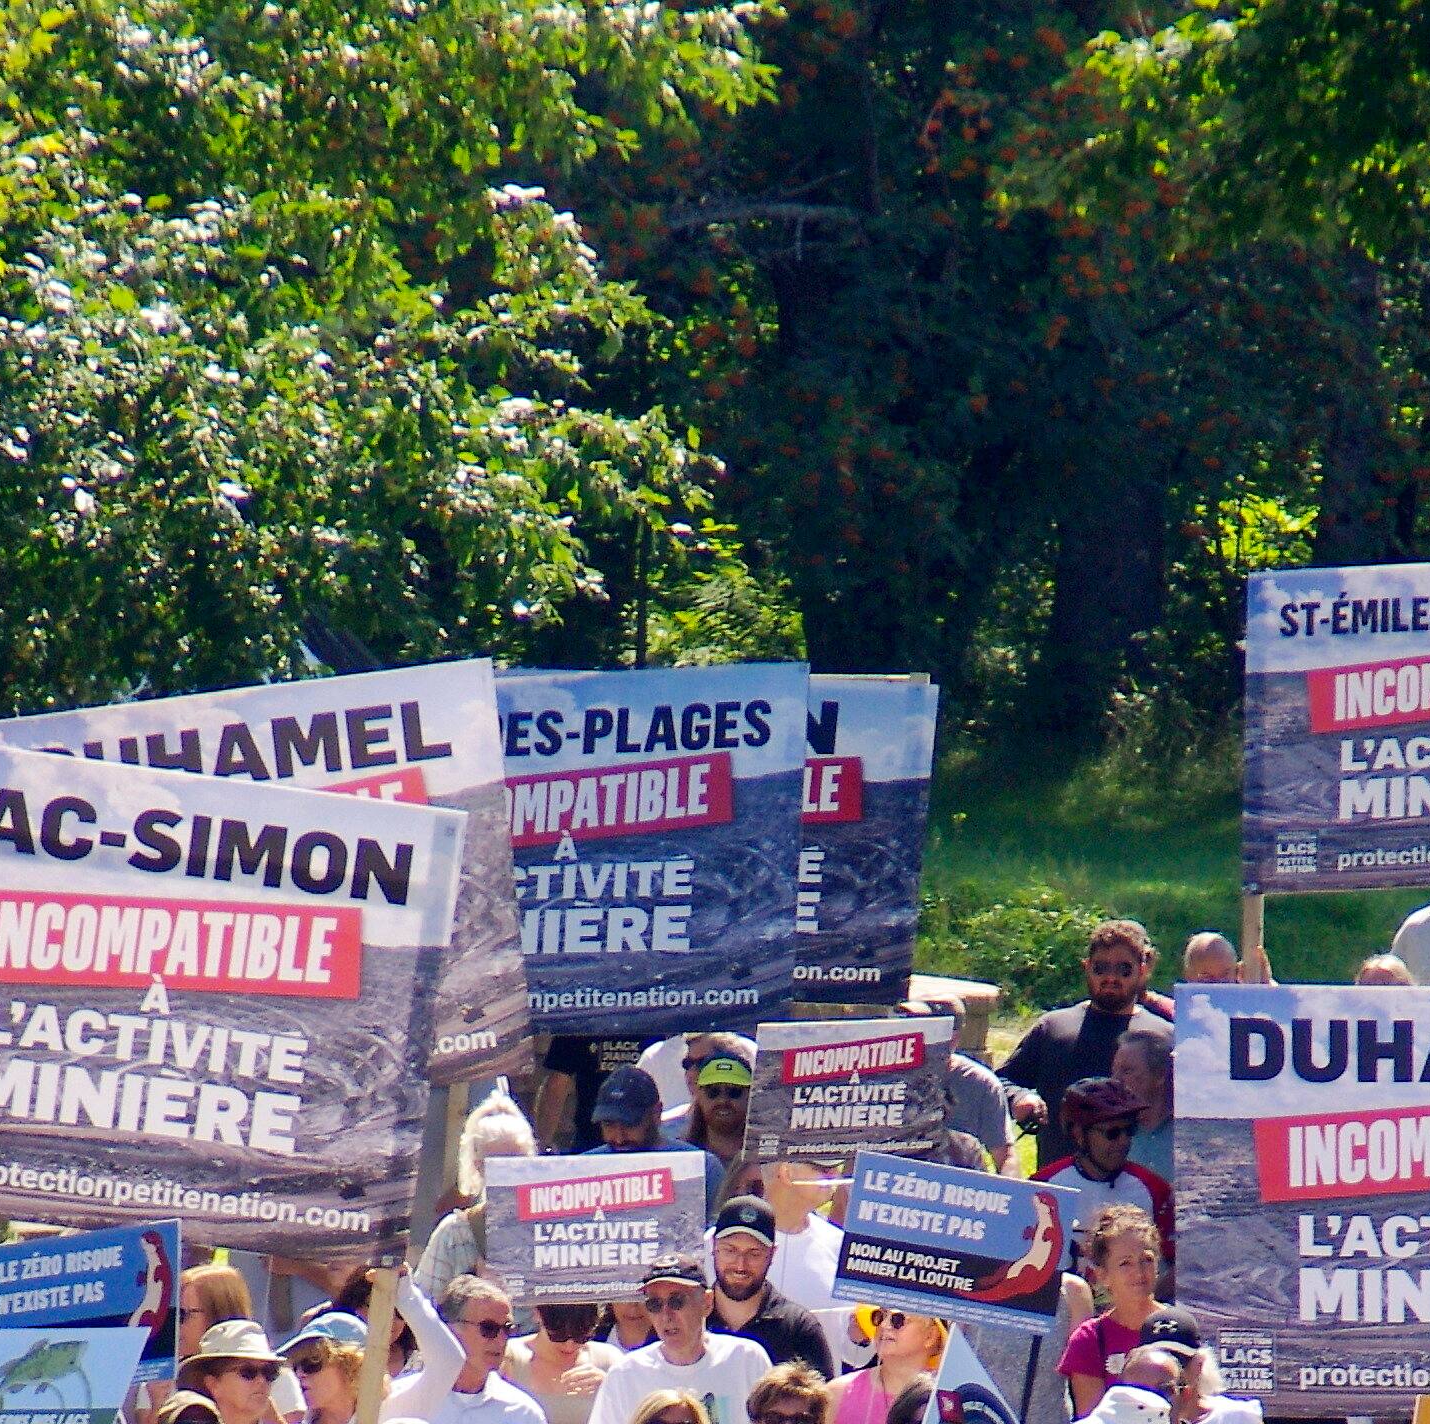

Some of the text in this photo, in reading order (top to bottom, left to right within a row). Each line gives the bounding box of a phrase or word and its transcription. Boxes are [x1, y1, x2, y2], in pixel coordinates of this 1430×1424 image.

[499, 700, 771, 756] ES-PLAGES
[554, 830, 578, 860] À
[142, 973, 170, 1015] À
[793, 1038, 915, 1077] INCOMPATIBLE
[530, 1174, 664, 1214] INCOMPATIBLE
[864, 1170, 1012, 1215] LE ZÉRO RISQUE
[858, 1201, 986, 1240] N'EXISTE PAS
[846, 1258, 974, 1291] MINIER LA LOUTRE
[849, 1242, 960, 1273] NON AU PROJET
[73, 1281, 105, 1303] PAS
[1220, 1348, 1272, 1364] LACS
